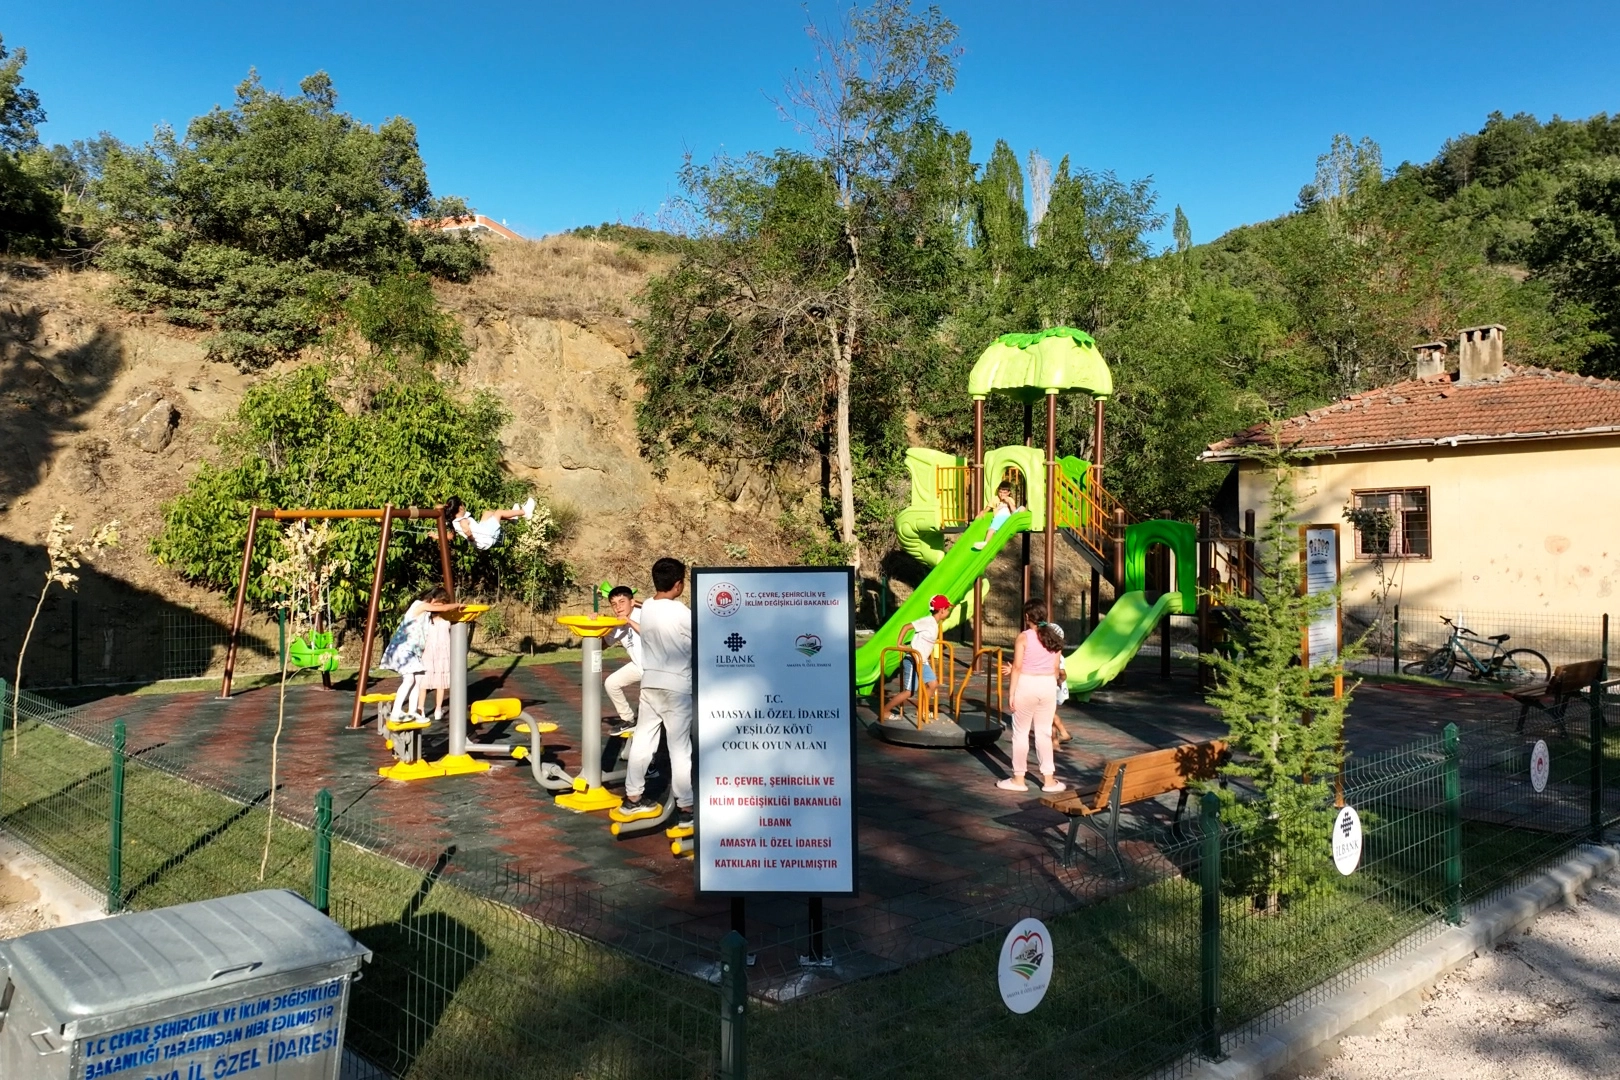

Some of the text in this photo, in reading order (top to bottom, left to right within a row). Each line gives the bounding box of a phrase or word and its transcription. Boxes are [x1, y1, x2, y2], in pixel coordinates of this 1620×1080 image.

[758, 591, 780, 600] ÇEVRE,
[782, 590, 816, 599] ŞEHİRCİLİK
[764, 598, 803, 608] DEĞİŞİKLİĞİ
[764, 694, 784, 704] T.C.
[710, 708, 840, 719] AMASYA İL ÖZEL İDARESİ
[736, 725, 812, 736] YEŞİLÖZ KÖYÜ
[722, 741, 827, 752] ÇOCUK OYUN ALANI
[715, 774, 835, 788] T.C. ÇEVRE, ŞEHİRCİLİK VE
[710, 796, 842, 808] İKLİM DEĞİŞİKLİĞİ BAKANLIĞI
[759, 816, 792, 827] İLBANK
[720, 836, 832, 848] AMASYA İL ÖZEL İDARESİ
[714, 858, 838, 870] KATKILARI İLE YAPILMIŞTIR
[109, 1026, 150, 1054] ÇEVRE
[223, 1007, 236, 1024] VE
[239, 998, 271, 1020] İKLİM
[85, 1043, 160, 1080] BAKANLIĞI
[163, 1027, 242, 1060] TARAFINDAN
[188, 1023, 339, 1080] İL ÖZEL İDARESİ
